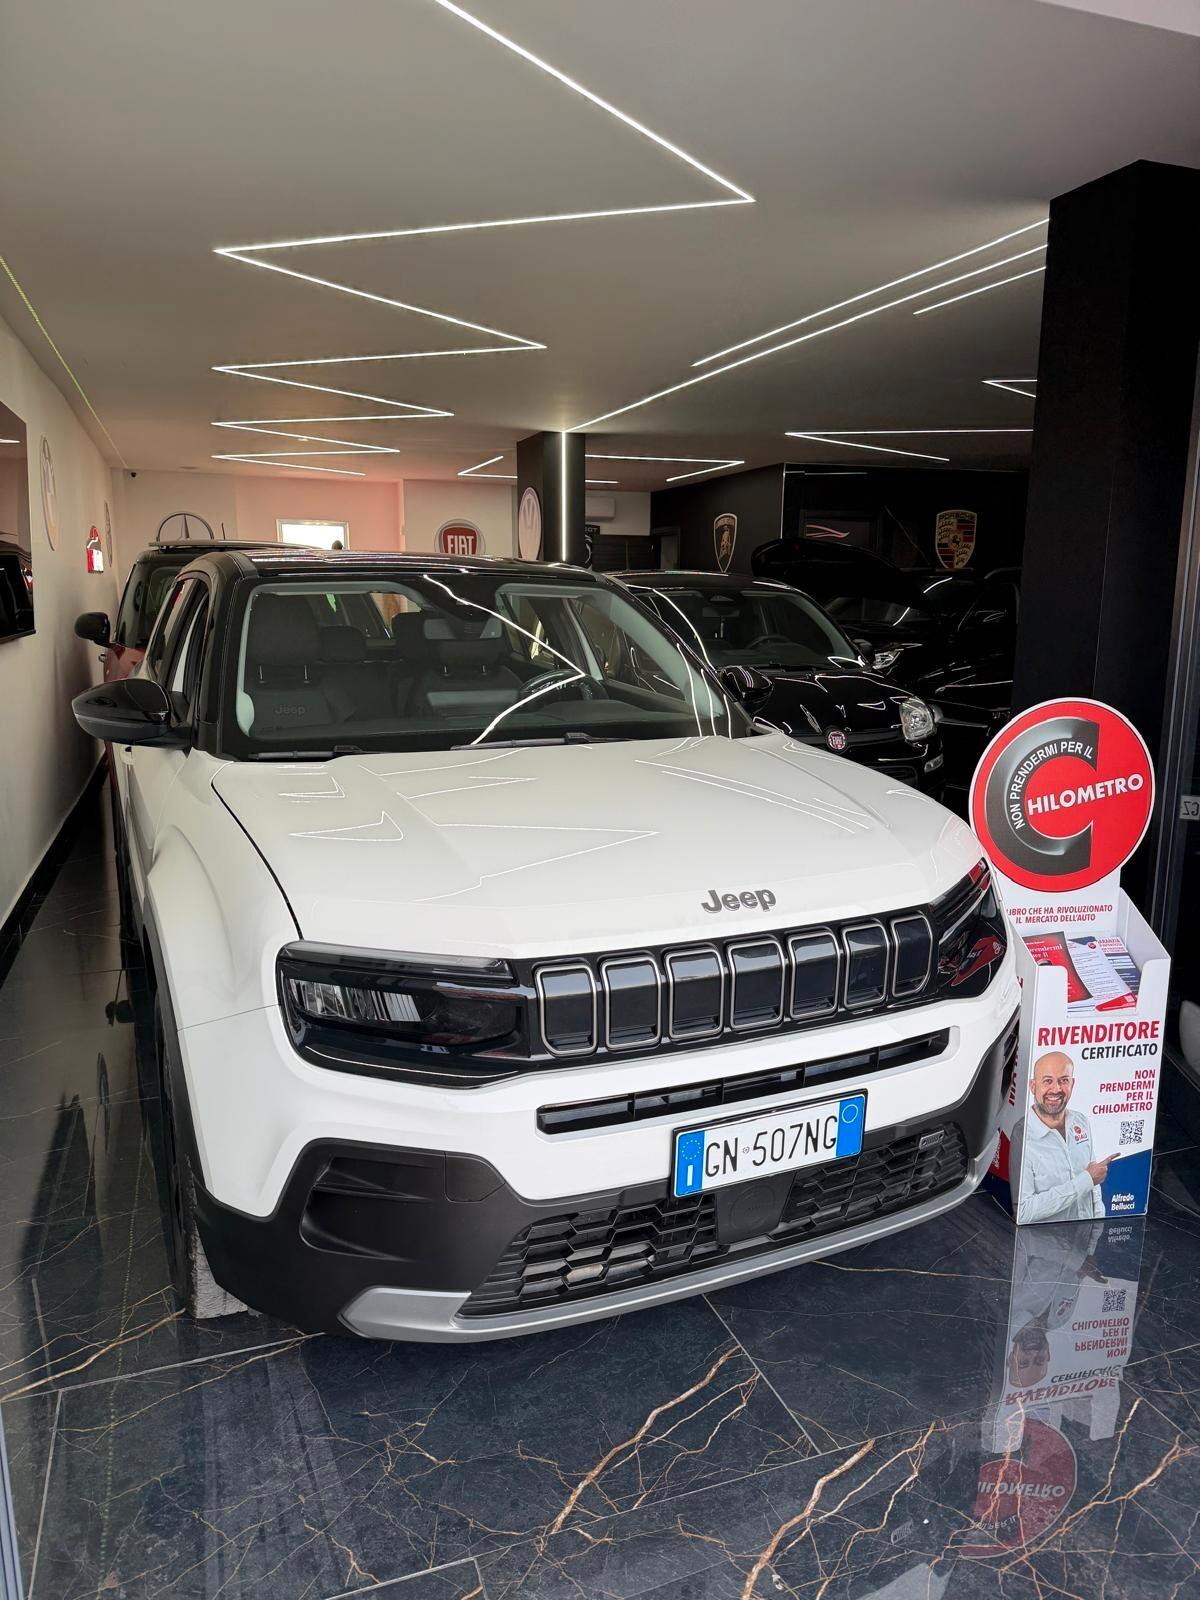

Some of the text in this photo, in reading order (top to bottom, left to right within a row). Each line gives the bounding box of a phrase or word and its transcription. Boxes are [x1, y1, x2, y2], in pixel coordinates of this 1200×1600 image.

[447, 534, 475, 555] FIAT
[1010, 741, 1094, 829] NON PRENDERMI PER IL
[700, 889, 777, 913] Jeep
[1028, 907, 1042, 915] CHE
[1044, 906, 1054, 914] HA
[1057, 904, 1113, 914] RIVOLUZIONATO
[1025, 915, 1059, 923] MERCATO
[1060, 913, 1096, 922] DELL'AUTO
[1038, 1021, 1160, 1046] RIVENDITORE
[1081, 1043, 1158, 1060] CERTIFICATO
[1135, 1069, 1155, 1080] NON
[1099, 1080, 1155, 1093] PRENDERMI
[1126, 1091, 1154, 1101] PER IL
[1092, 1101, 1153, 1115] CHILOMETRO
[705, 1137, 738, 1177] GN
[752, 1115, 838, 1167] 507NG
[1111, 1193, 1135, 1202] Alfredo
[1111, 1202, 1136, 1211] Bellucci
